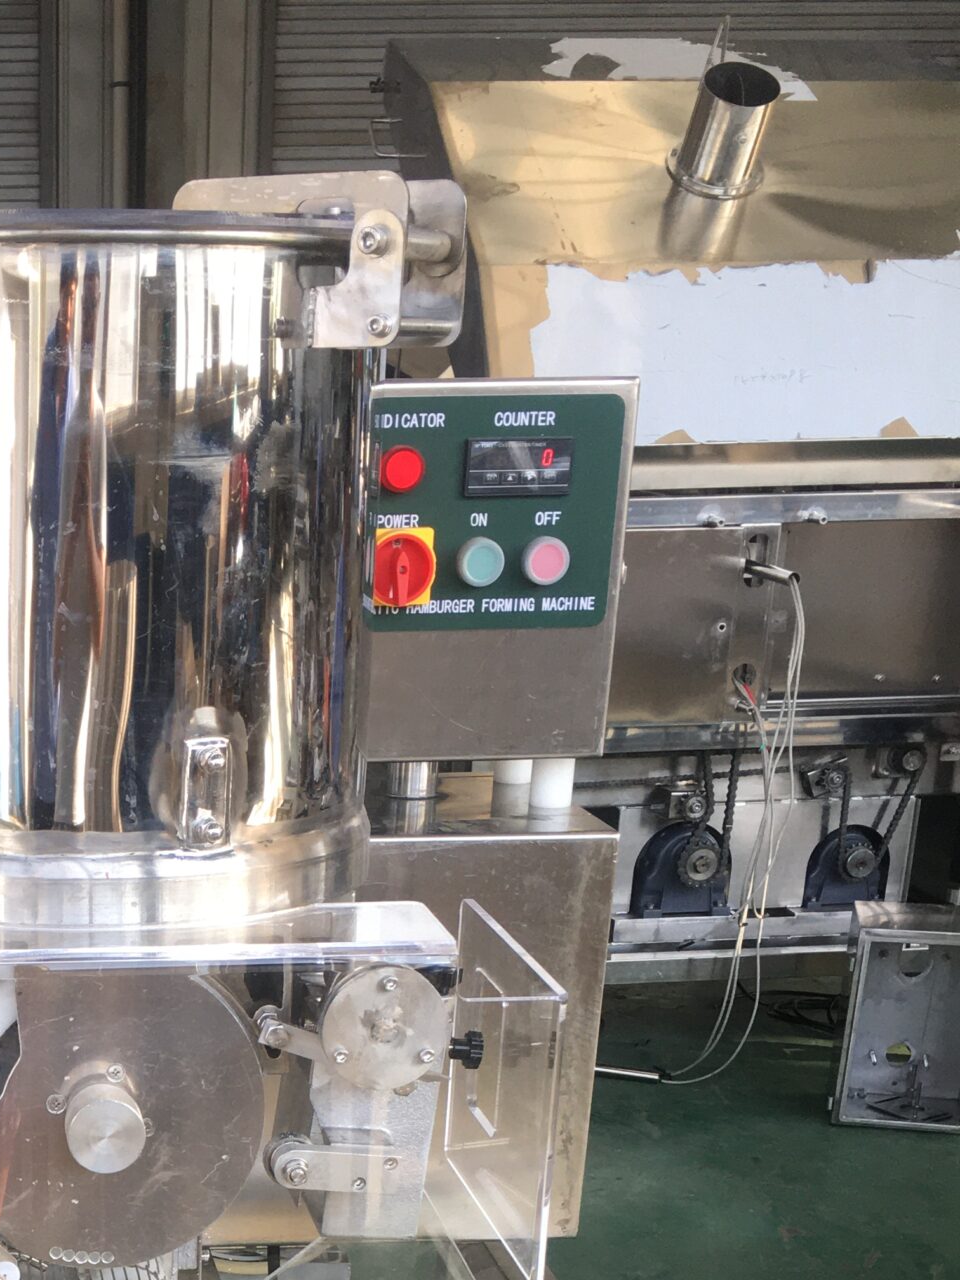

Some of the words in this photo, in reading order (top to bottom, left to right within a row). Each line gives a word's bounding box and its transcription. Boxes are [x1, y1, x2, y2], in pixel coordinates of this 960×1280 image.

[383, 412, 446, 429] DICATOR
[494, 410, 556, 427] COUNTER
[542, 448, 553, 466] 0
[377, 514, 420, 528] POWER
[470, 512, 488, 527] ON
[535, 511, 562, 526] OFF
[406, 599, 475, 614] HAMBURGER
[481, 598, 535, 613] FORMING
[542, 596, 596, 611] MACHINE
